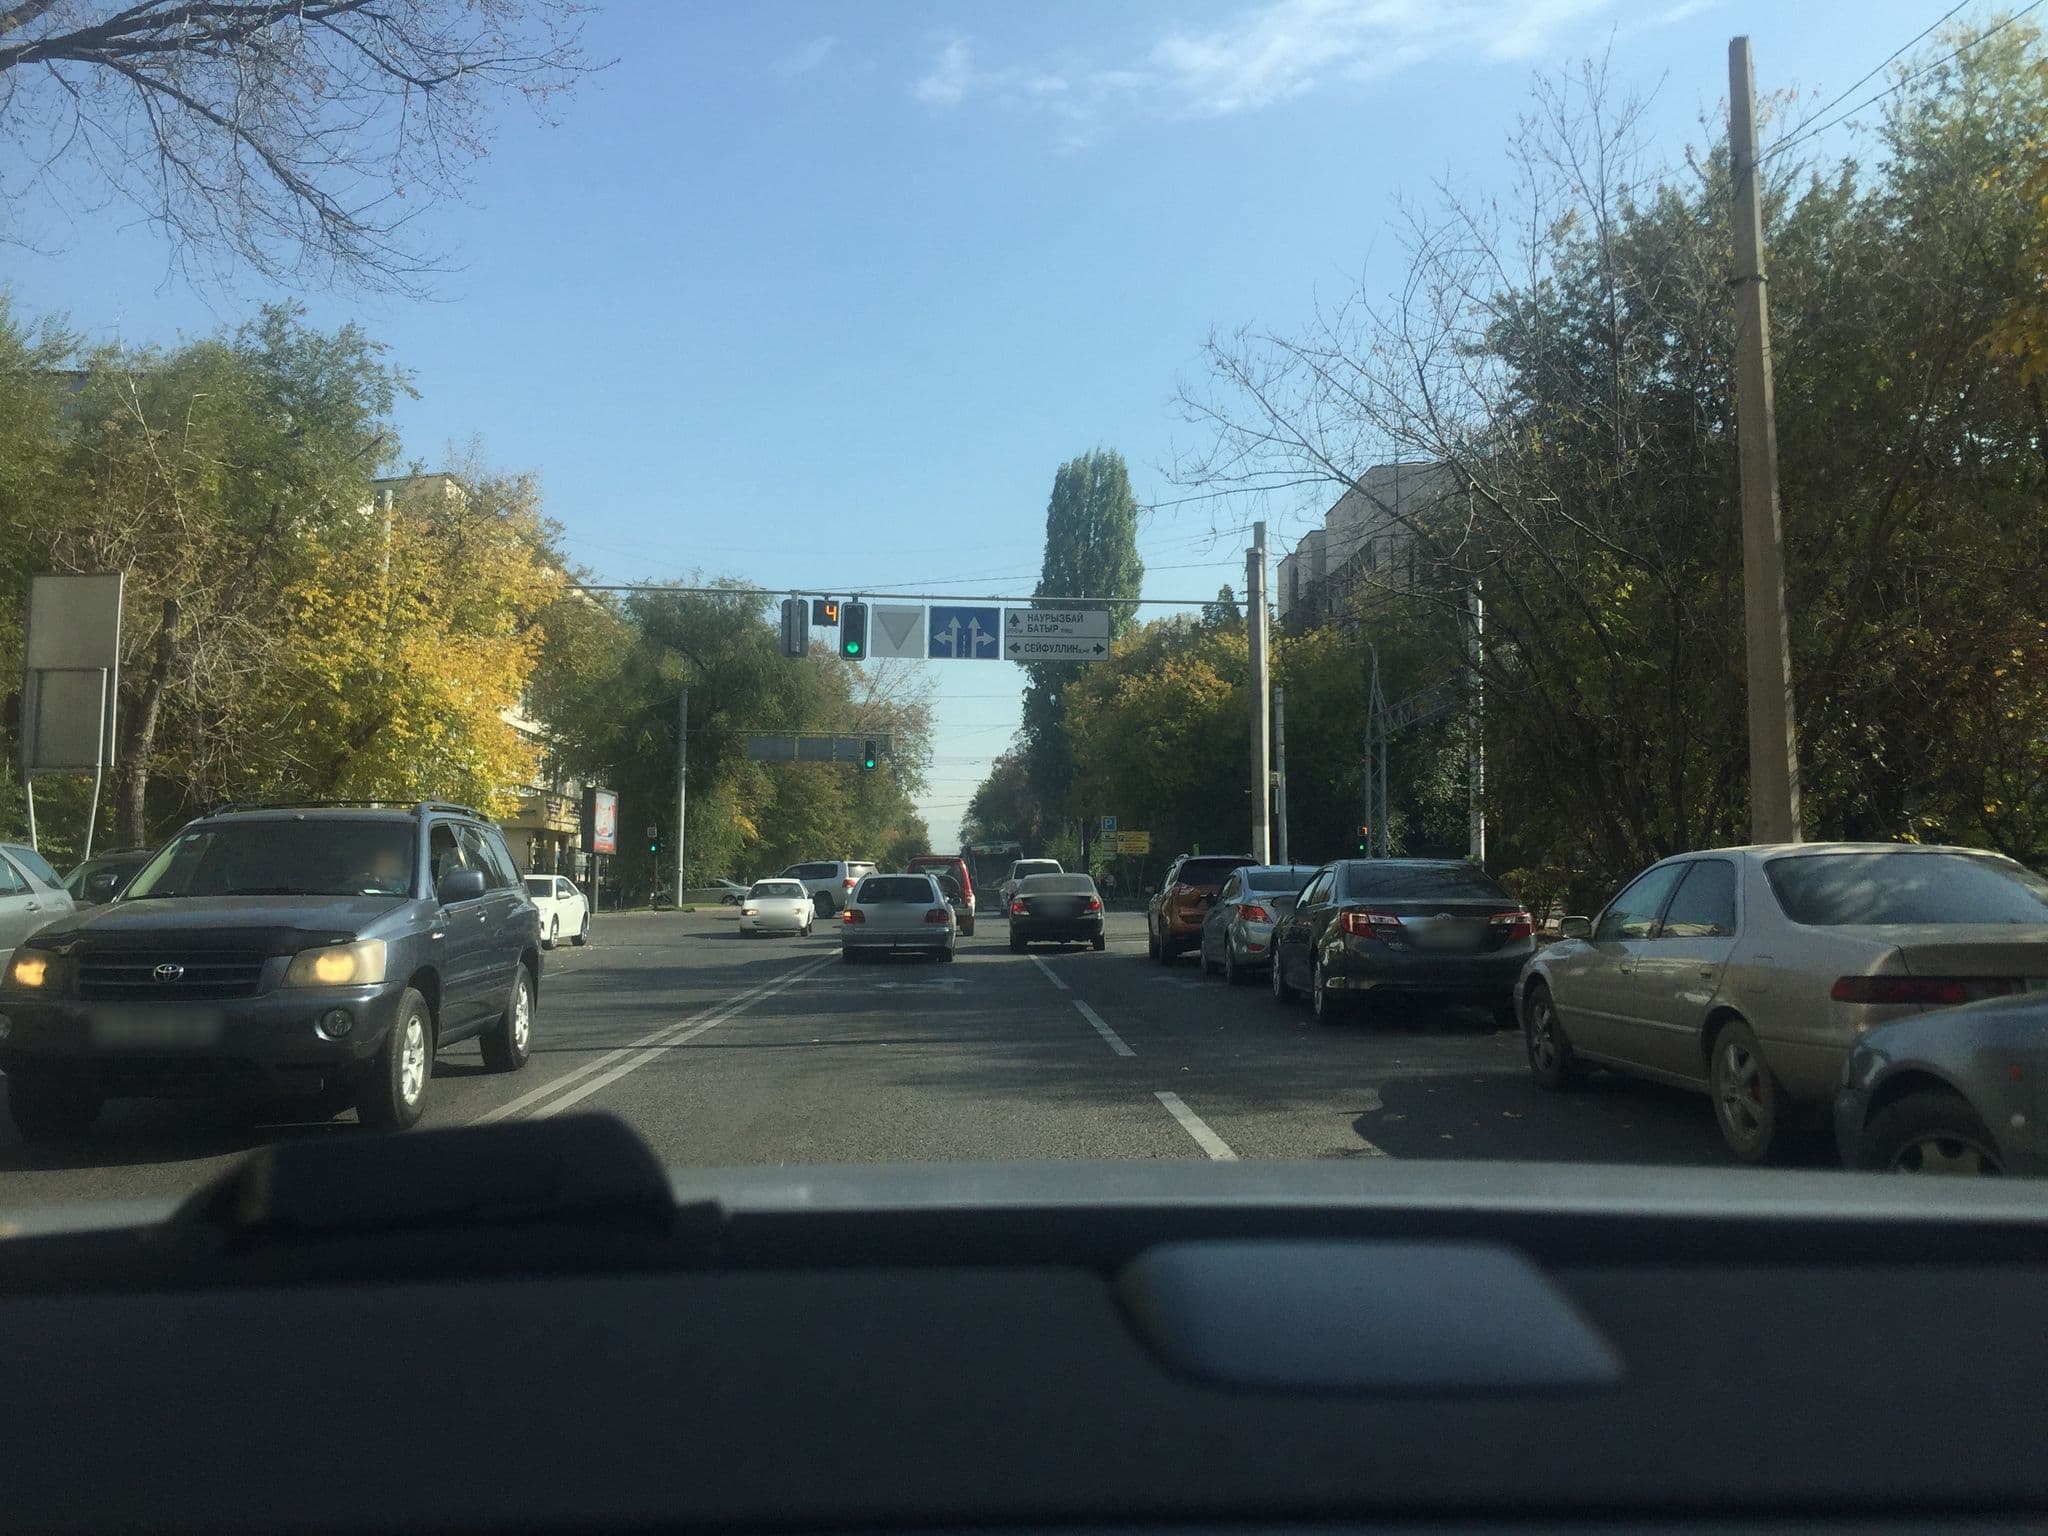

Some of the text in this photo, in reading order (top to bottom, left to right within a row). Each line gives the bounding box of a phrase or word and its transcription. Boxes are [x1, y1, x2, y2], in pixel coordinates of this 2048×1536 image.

[826, 605, 837, 621] 4
[1027, 612, 1084, 623] НАУРЫЗБАЙ
[1027, 624, 1059, 633] БАТЫР
[1024, 641, 1078, 653] СЕЙФУЛЛИН
[1104, 818, 1113, 828] P
